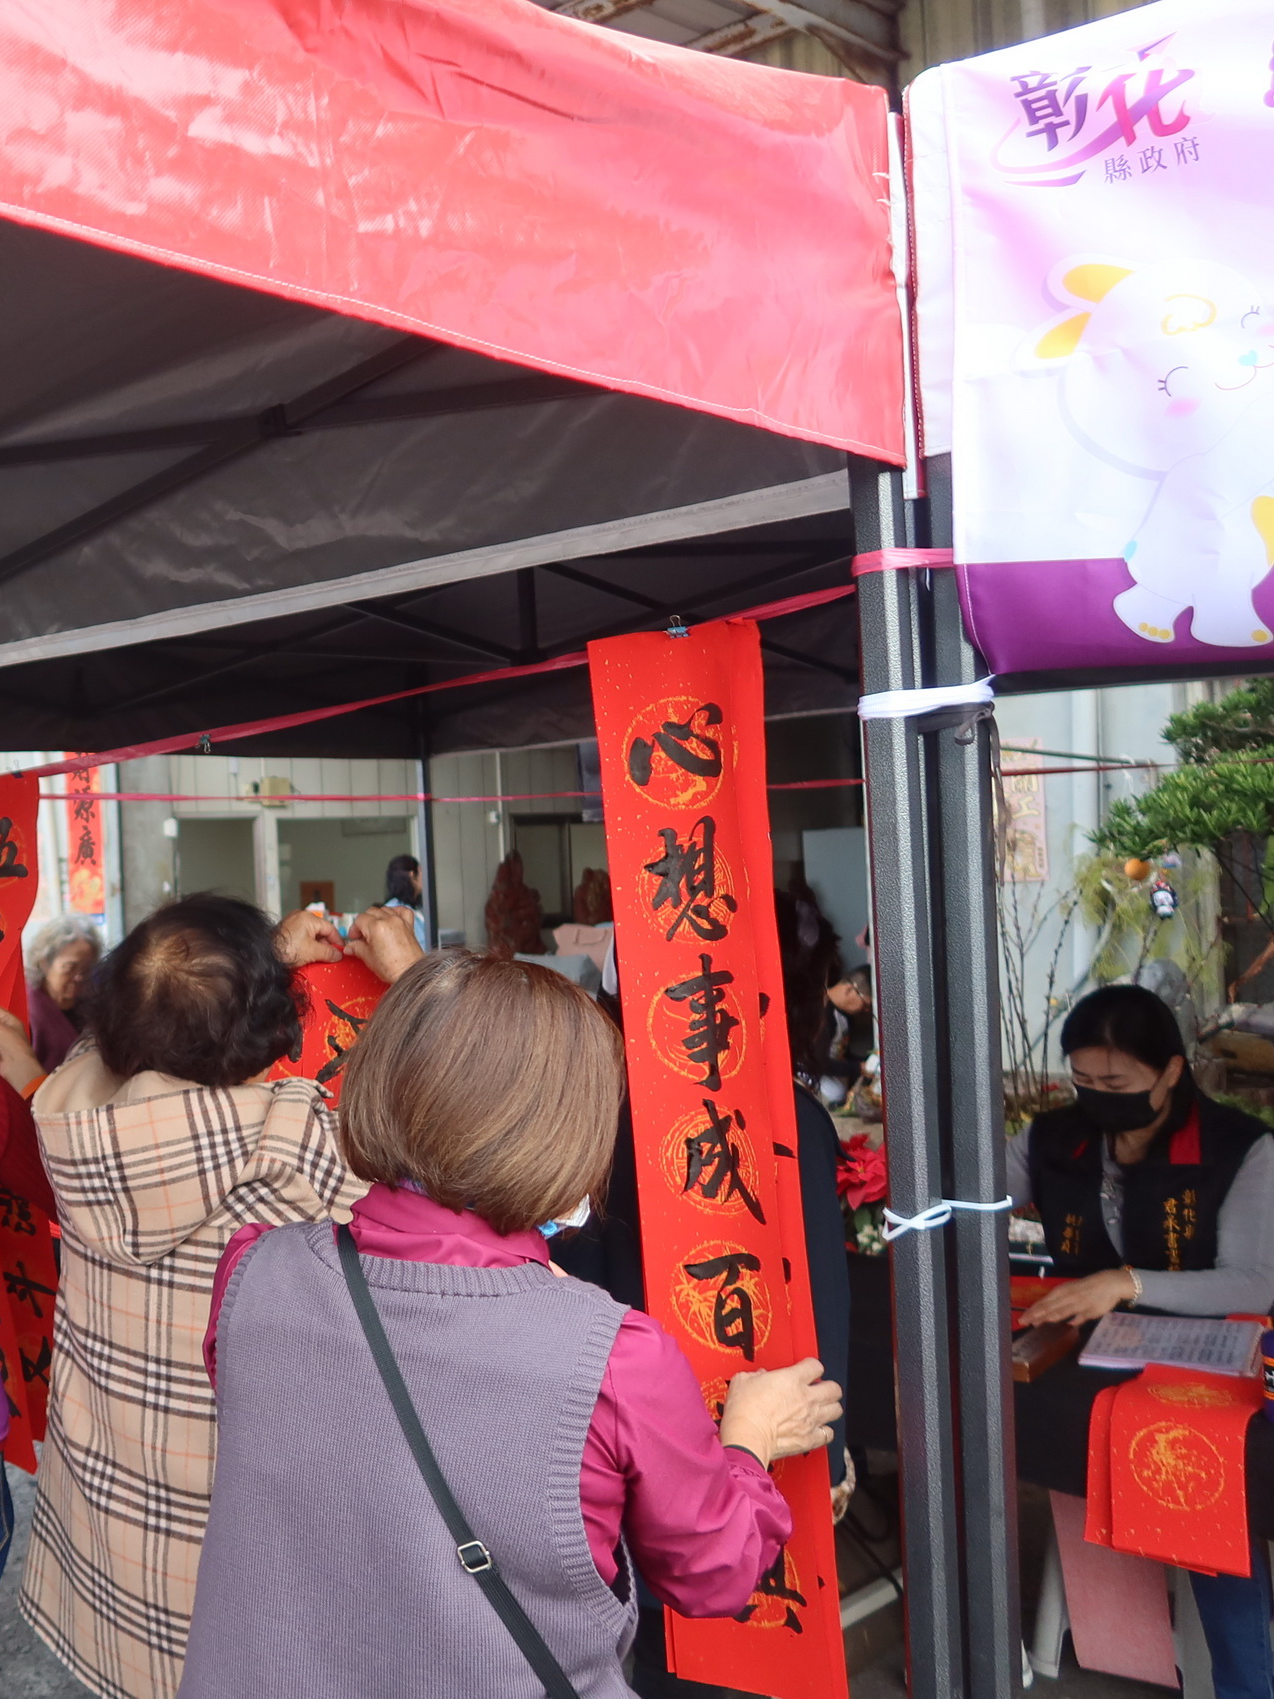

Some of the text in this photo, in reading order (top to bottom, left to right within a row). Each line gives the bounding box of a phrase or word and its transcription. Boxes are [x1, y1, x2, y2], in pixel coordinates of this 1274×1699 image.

[1010, 65, 1196, 152] 彰化
[1104, 136, 1201, 184] 縣政府
[629, 702, 807, 1634] 心想事成百
